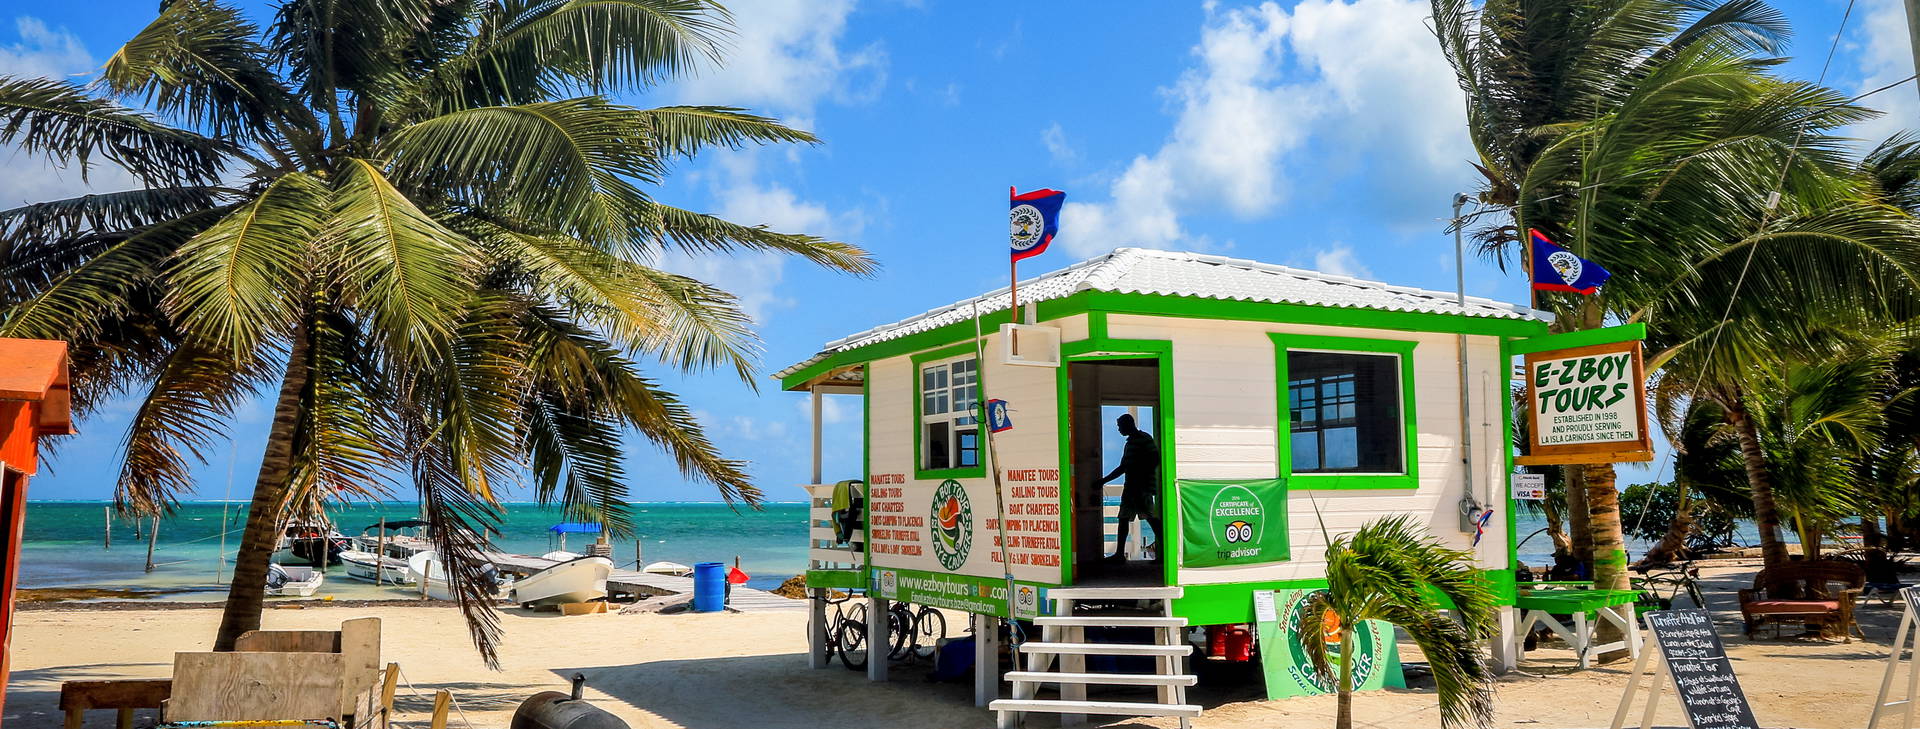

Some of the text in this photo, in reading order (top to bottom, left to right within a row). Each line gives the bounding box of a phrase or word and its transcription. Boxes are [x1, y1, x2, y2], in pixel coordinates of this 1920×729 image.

[1539, 383, 1628, 414] TOURS
[1554, 414, 1593, 423] ESTABLISHED
[1602, 412, 1617, 420] 1998
[1566, 423, 1593, 432] PROUDLY
[1595, 422, 1621, 430] SERVING
[1541, 436, 1549, 444] LA
[1550, 435, 1563, 443] ISLA
[1596, 432, 1614, 440] SINCE
[1616, 431, 1633, 439] THEN
[1008, 470, 1059, 481] MANATEE TOURS
[940, 482, 951, 497] BOY
[1012, 486, 1058, 498] SAILING TOURS
[1009, 504, 1059, 515] BOAT CHARTERS
[1215, 507, 1260, 517] EXCELLENCE
[1022, 520, 1028, 531] TO
[1029, 520, 1059, 532] PLACENCIA
[1046, 537, 1060, 549] ATOLL
[991, 552, 1004, 562] FULL
[1217, 547, 1259, 560] tripadvisor
[1658, 630, 1664, 638] 3
[1672, 660, 1719, 673] Manatee Tour
